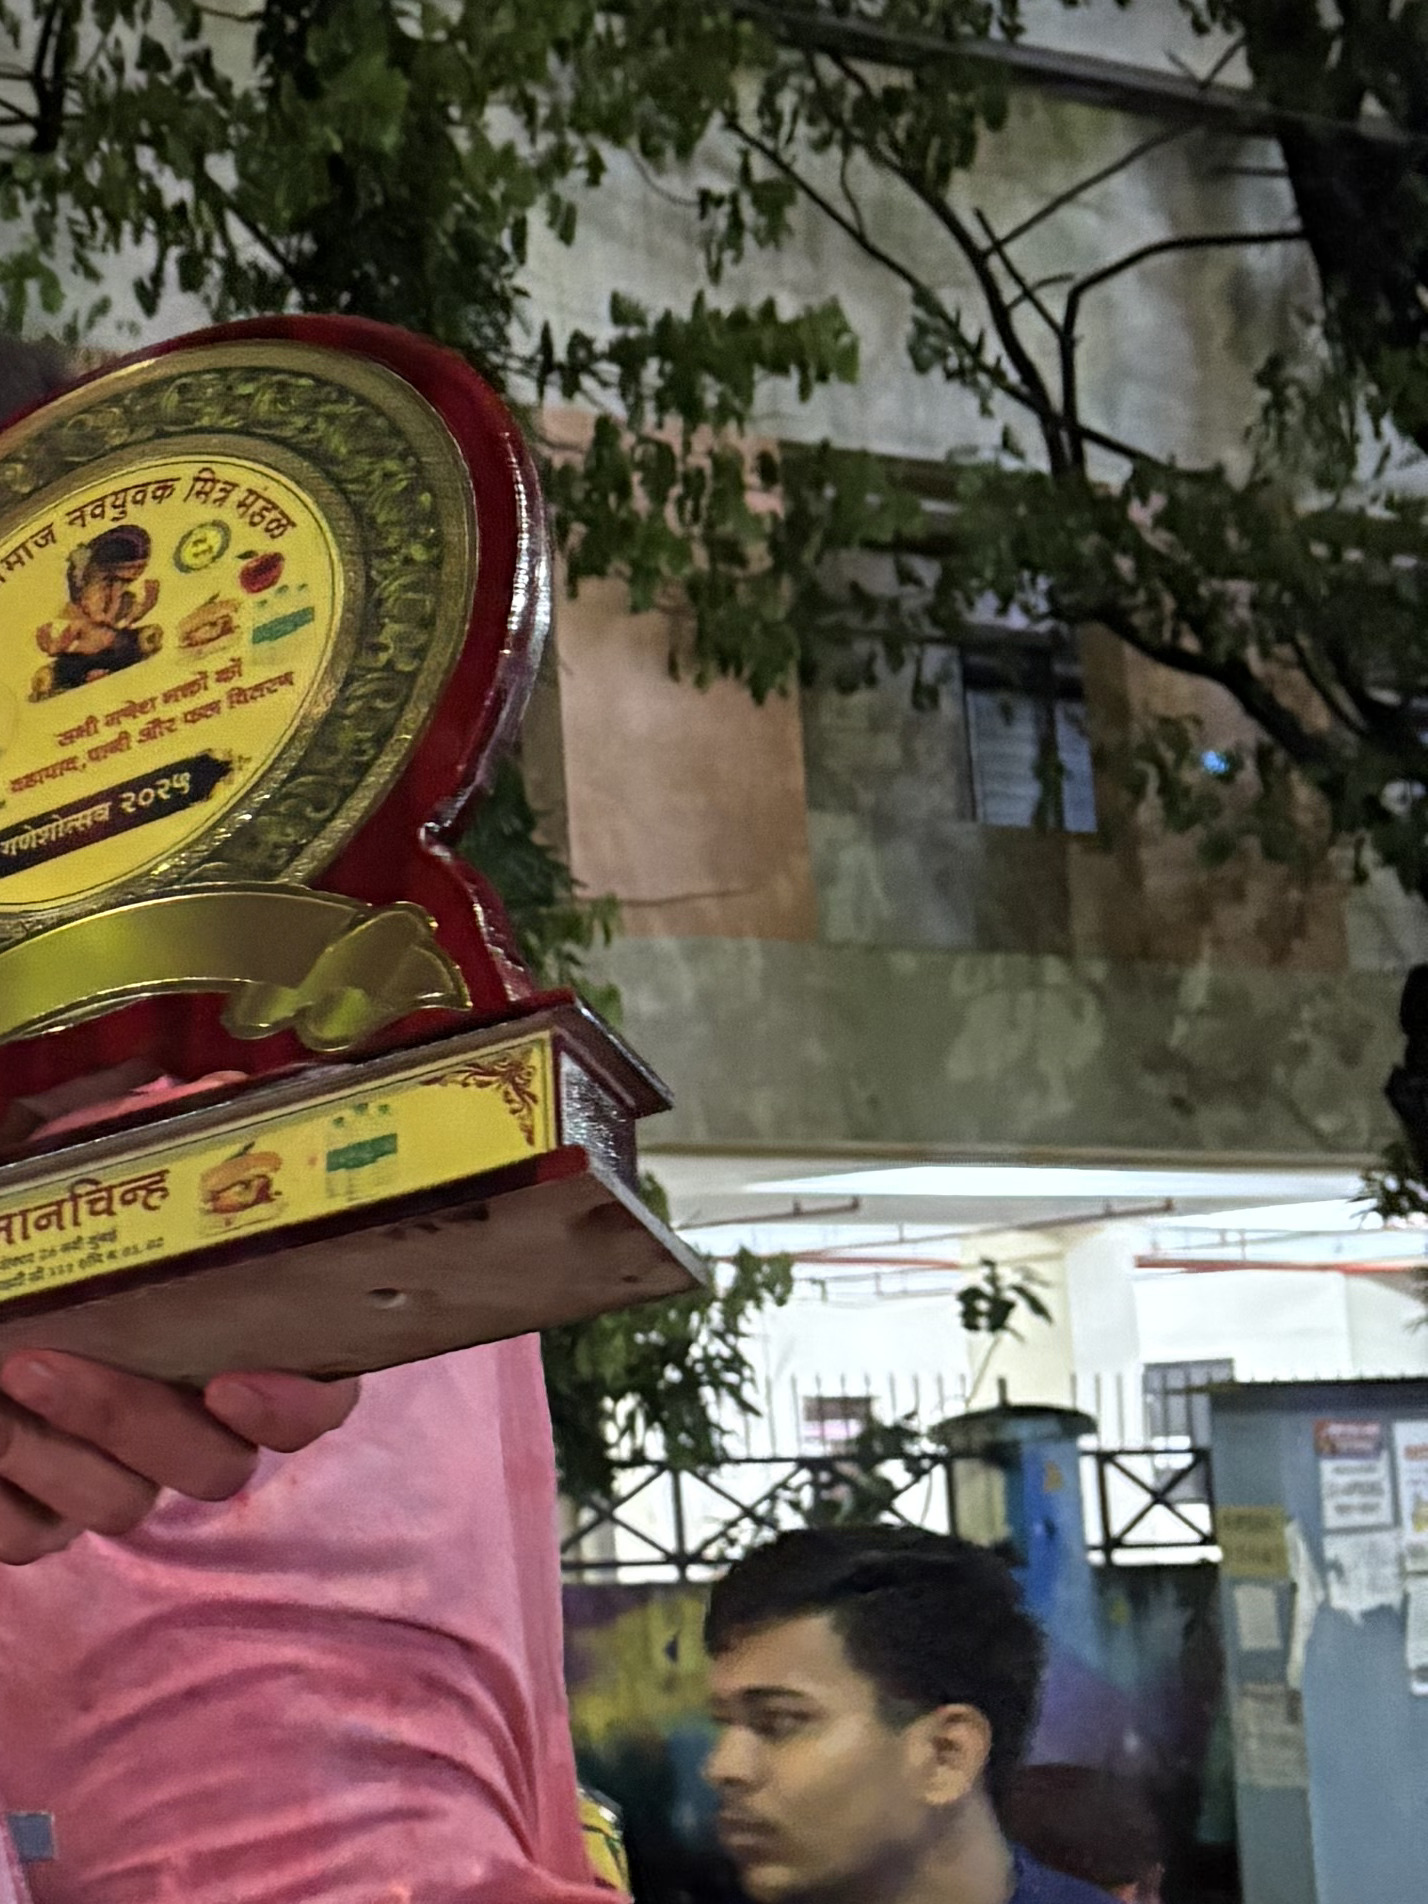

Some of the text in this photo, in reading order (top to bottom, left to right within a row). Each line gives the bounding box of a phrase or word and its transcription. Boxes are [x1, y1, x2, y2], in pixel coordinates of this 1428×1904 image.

[64, 477, 182, 529] नवयुवक
[183, 467, 241, 509] मित्र
[0, 800, 112, 860] गणेशोत्सव
[119, 770, 194, 820] २०२५
